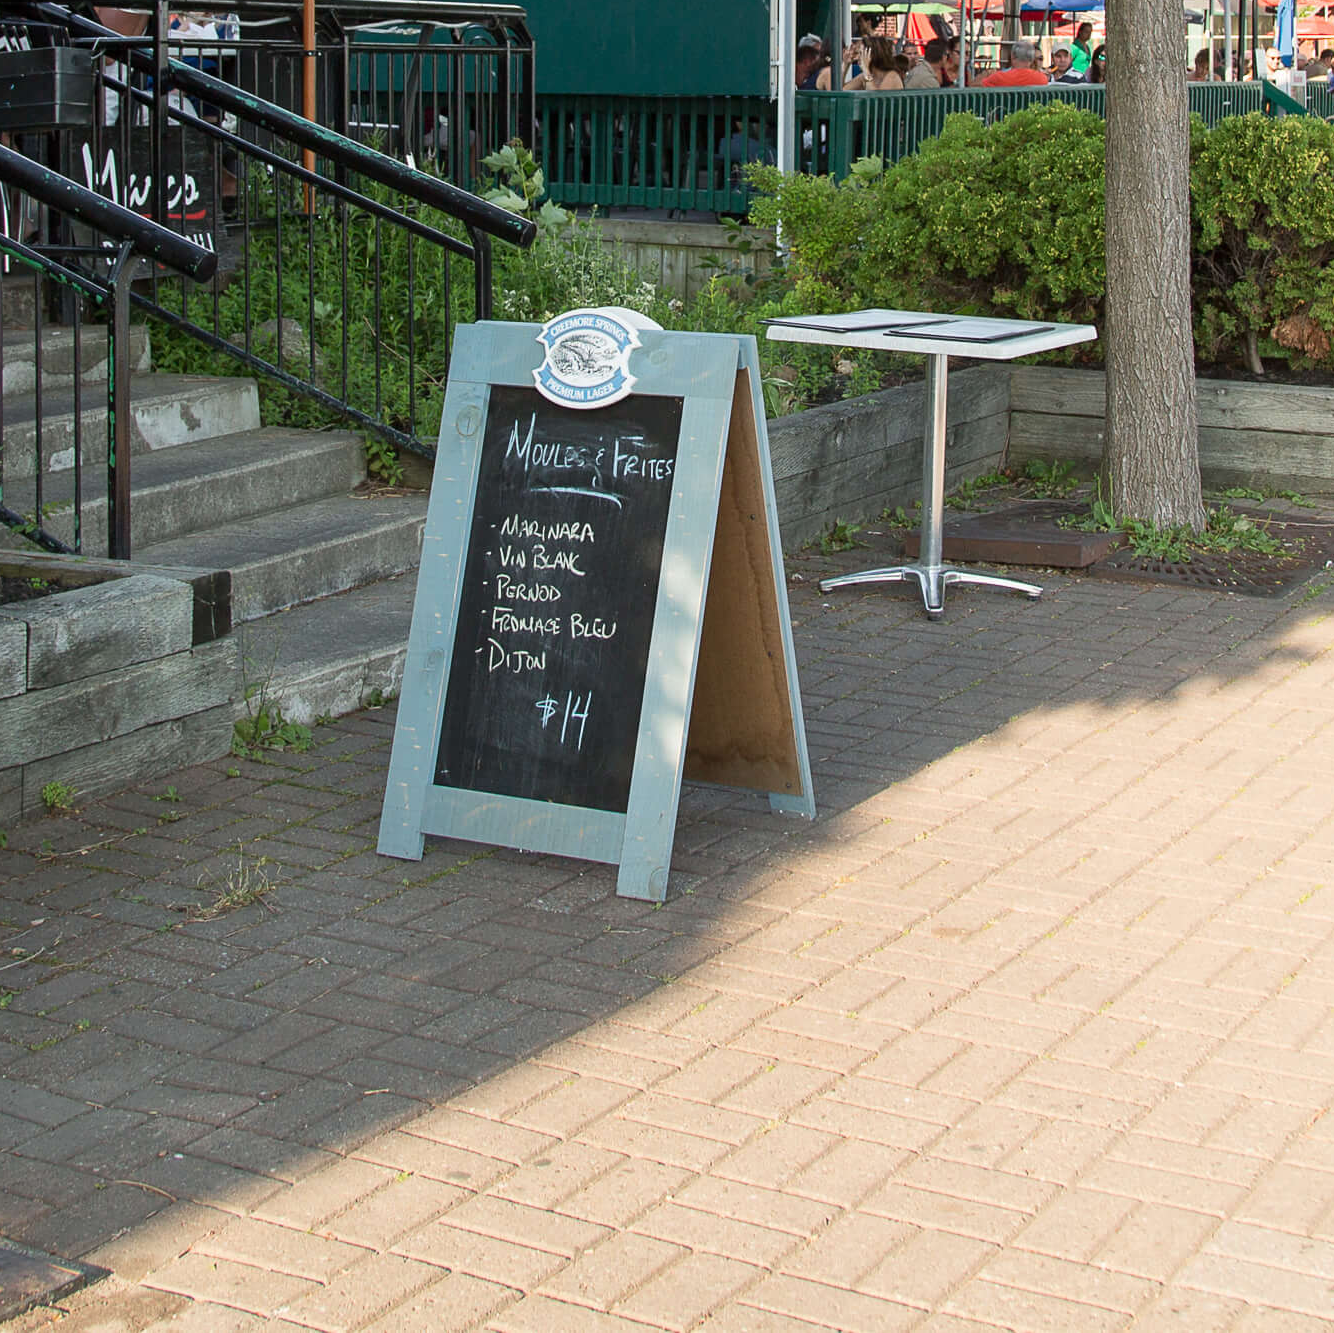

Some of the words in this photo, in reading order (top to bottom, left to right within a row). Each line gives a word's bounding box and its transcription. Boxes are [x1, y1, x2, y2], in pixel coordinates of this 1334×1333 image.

[550, 317, 595, 337] CREEMORE
[595, 318, 626, 340] SPRINGS
[547, 378, 585, 401] PREMIUM
[586, 383, 615, 400] LAGER
[612, 436, 674, 481] FRITES
[500, 514, 595, 543] MARINARA
[499, 545, 526, 569] VIN
[533, 543, 586, 577] BLANC
[496, 574, 562, 602] PERNOD
[492, 596, 562, 637] FROMAGE
[570, 613, 617, 639] BLEU
[487, 637, 547, 674] DIJON
